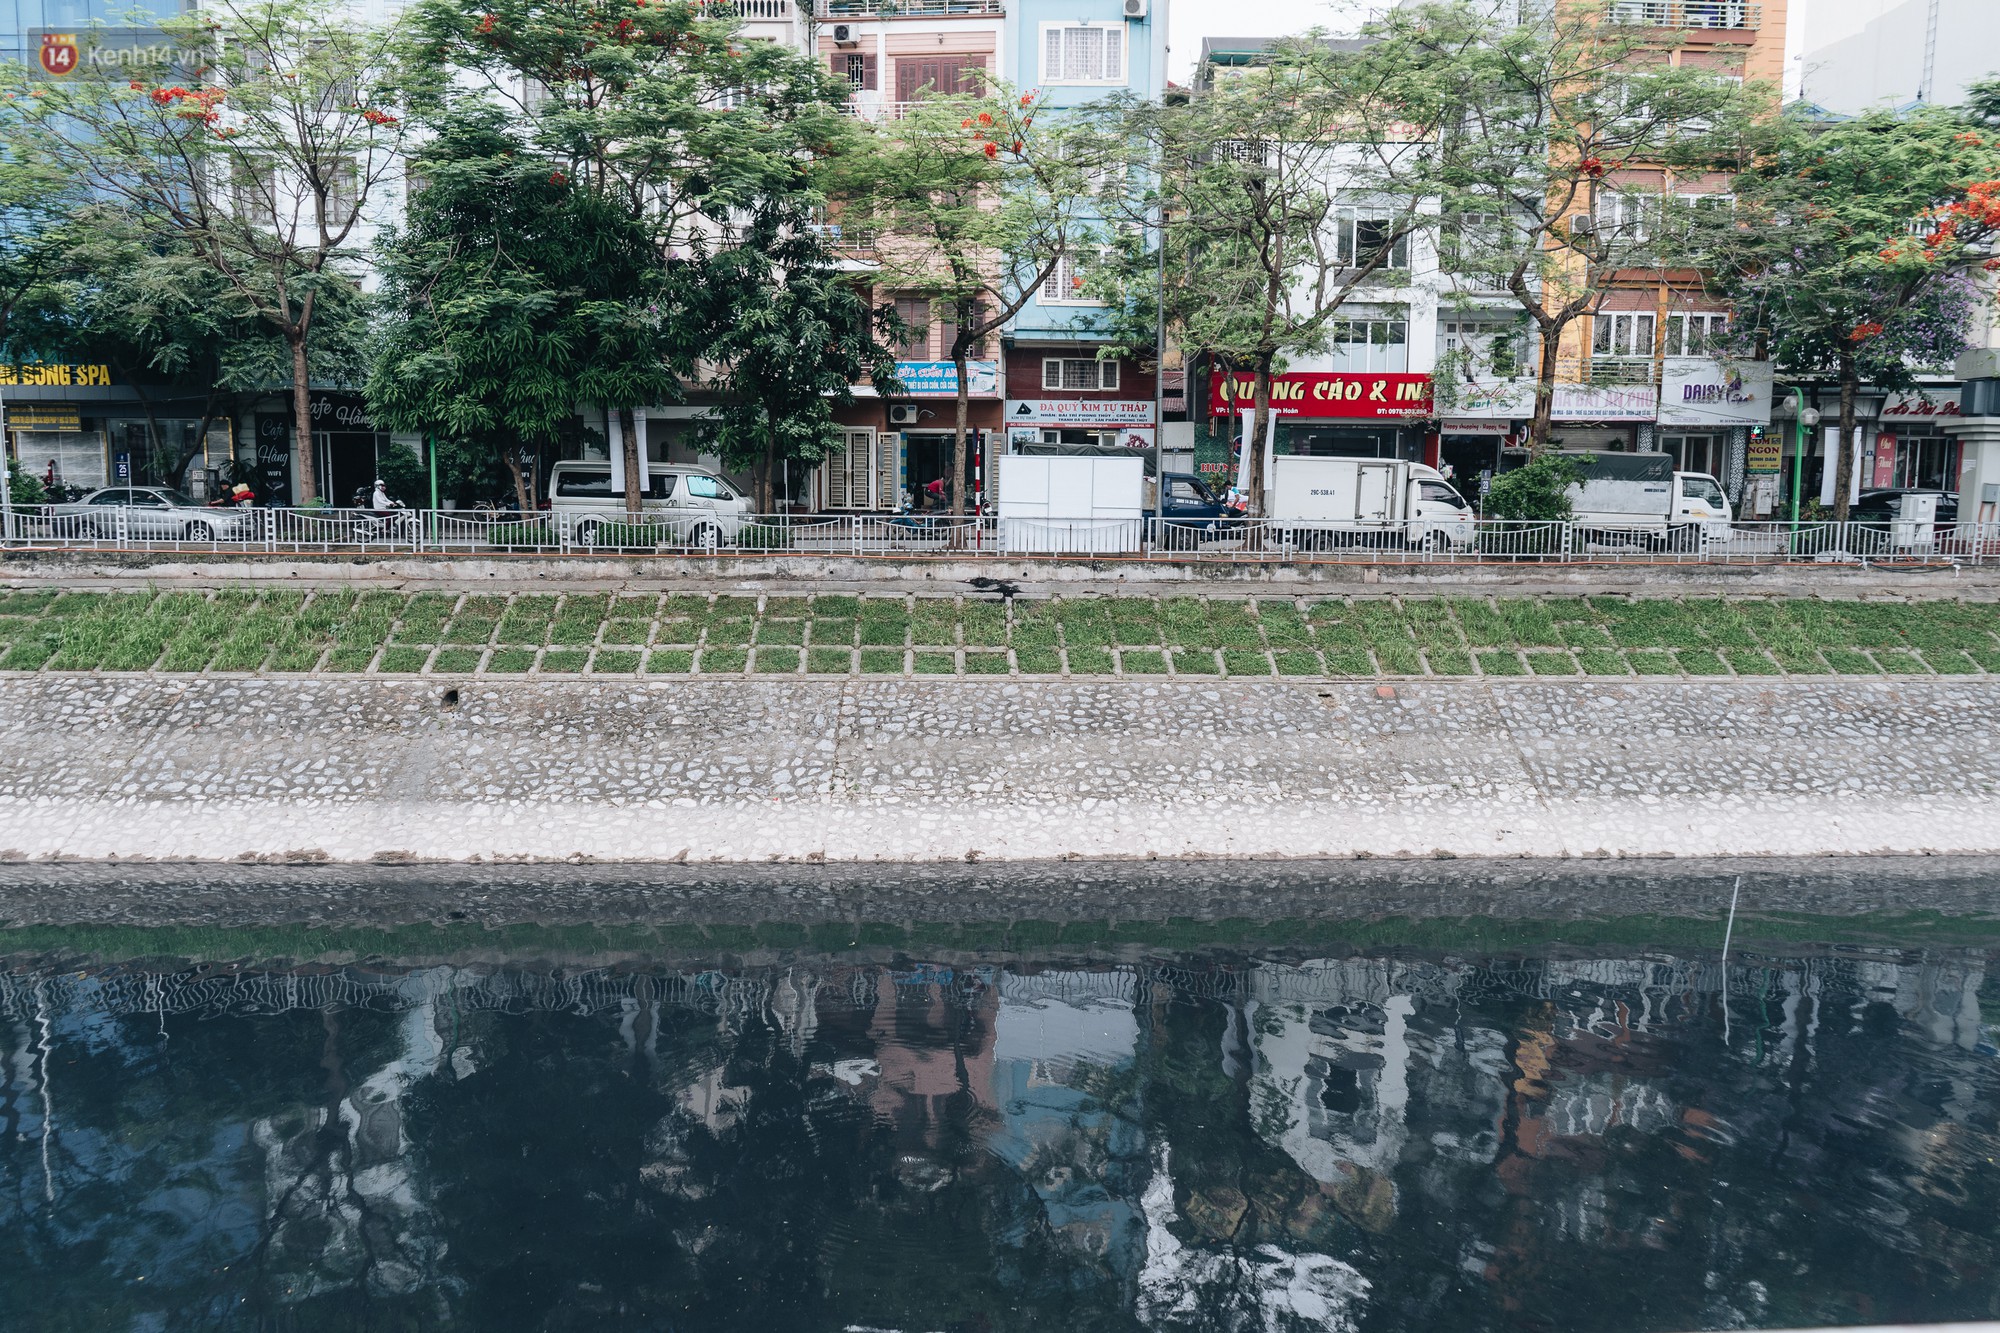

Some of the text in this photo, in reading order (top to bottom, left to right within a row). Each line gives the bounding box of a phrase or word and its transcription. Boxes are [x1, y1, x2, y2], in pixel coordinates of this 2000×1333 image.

[76, 365, 111, 386] SPA
[1219, 377, 1305, 401] QUNG
[1312, 378, 1363, 401] CÁO
[1395, 382, 1424, 401] IN
[1627, 388, 1654, 408] PHÚ
[1683, 384, 1726, 400] DAISY
[1040, 401, 1147, 414] ĐÁ QUÝ KIM TỰ THÁP
